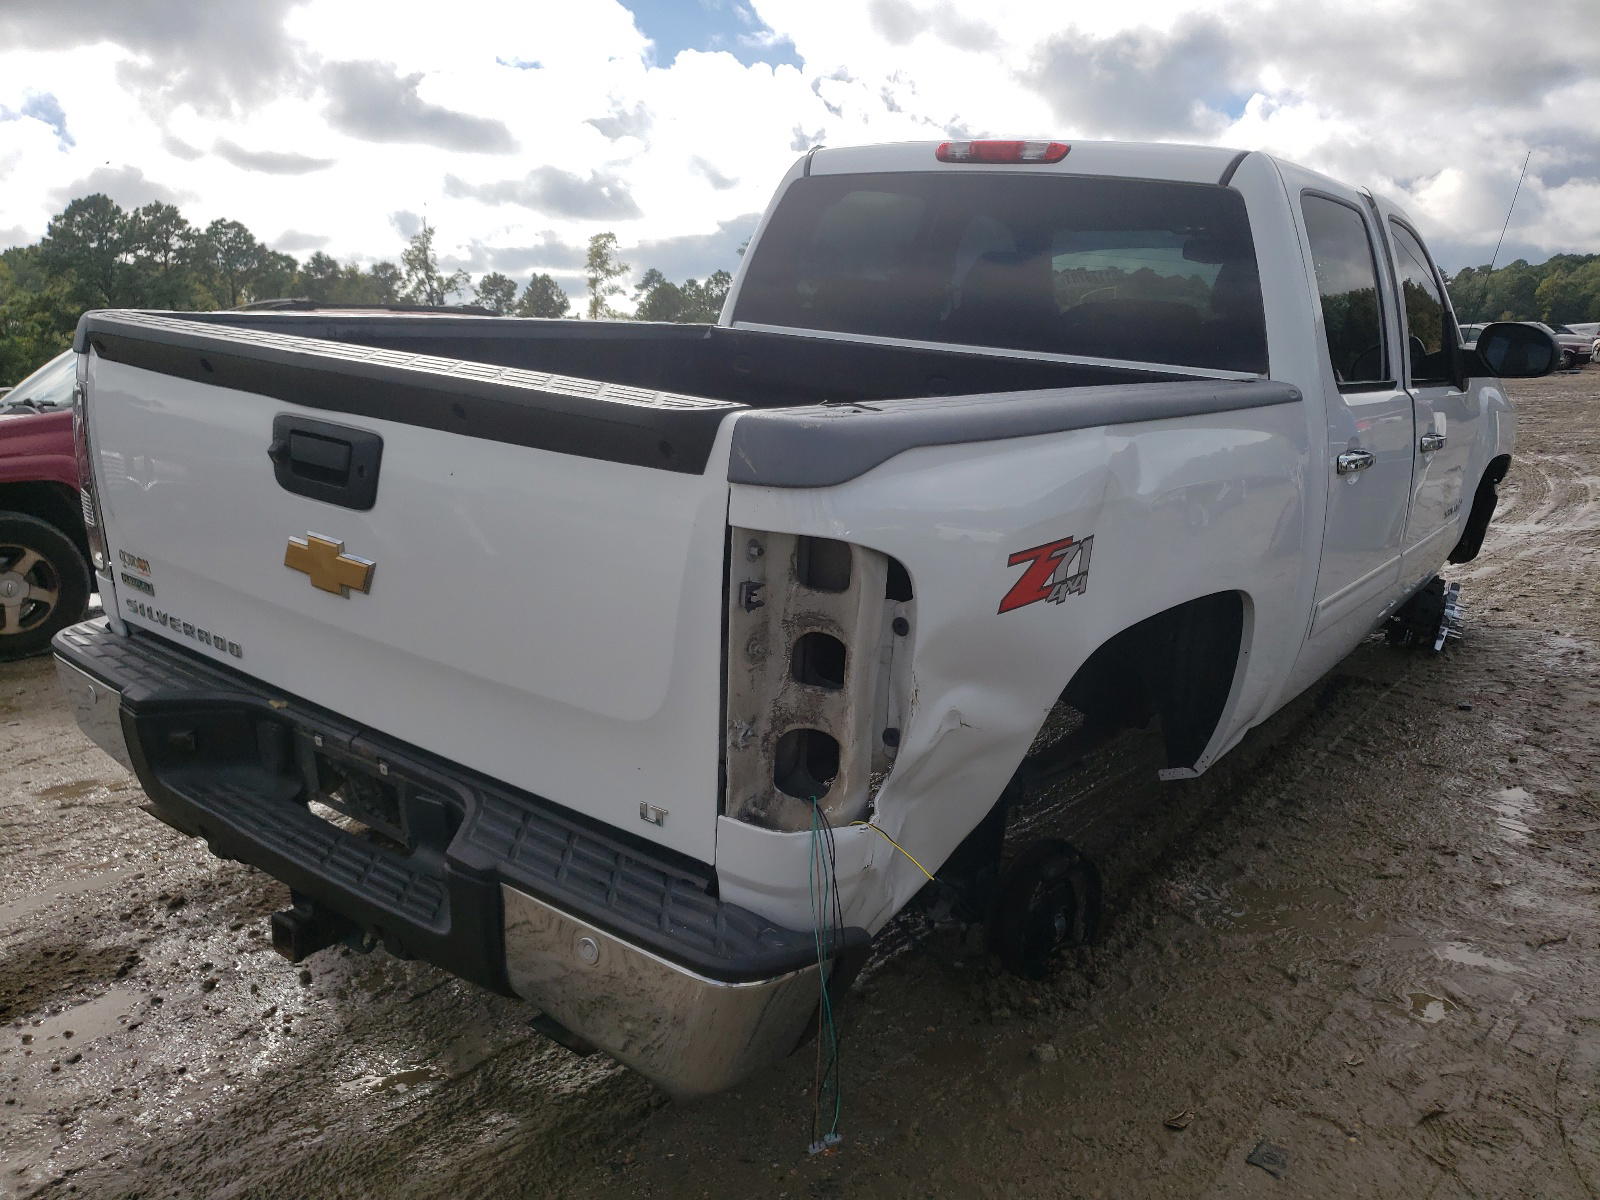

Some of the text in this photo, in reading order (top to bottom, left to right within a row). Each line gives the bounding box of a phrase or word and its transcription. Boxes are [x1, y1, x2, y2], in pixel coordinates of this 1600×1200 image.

[997, 534, 1094, 615] Z71
[126, 598, 243, 659] SILVERADO
[640, 800, 669, 828] LT
